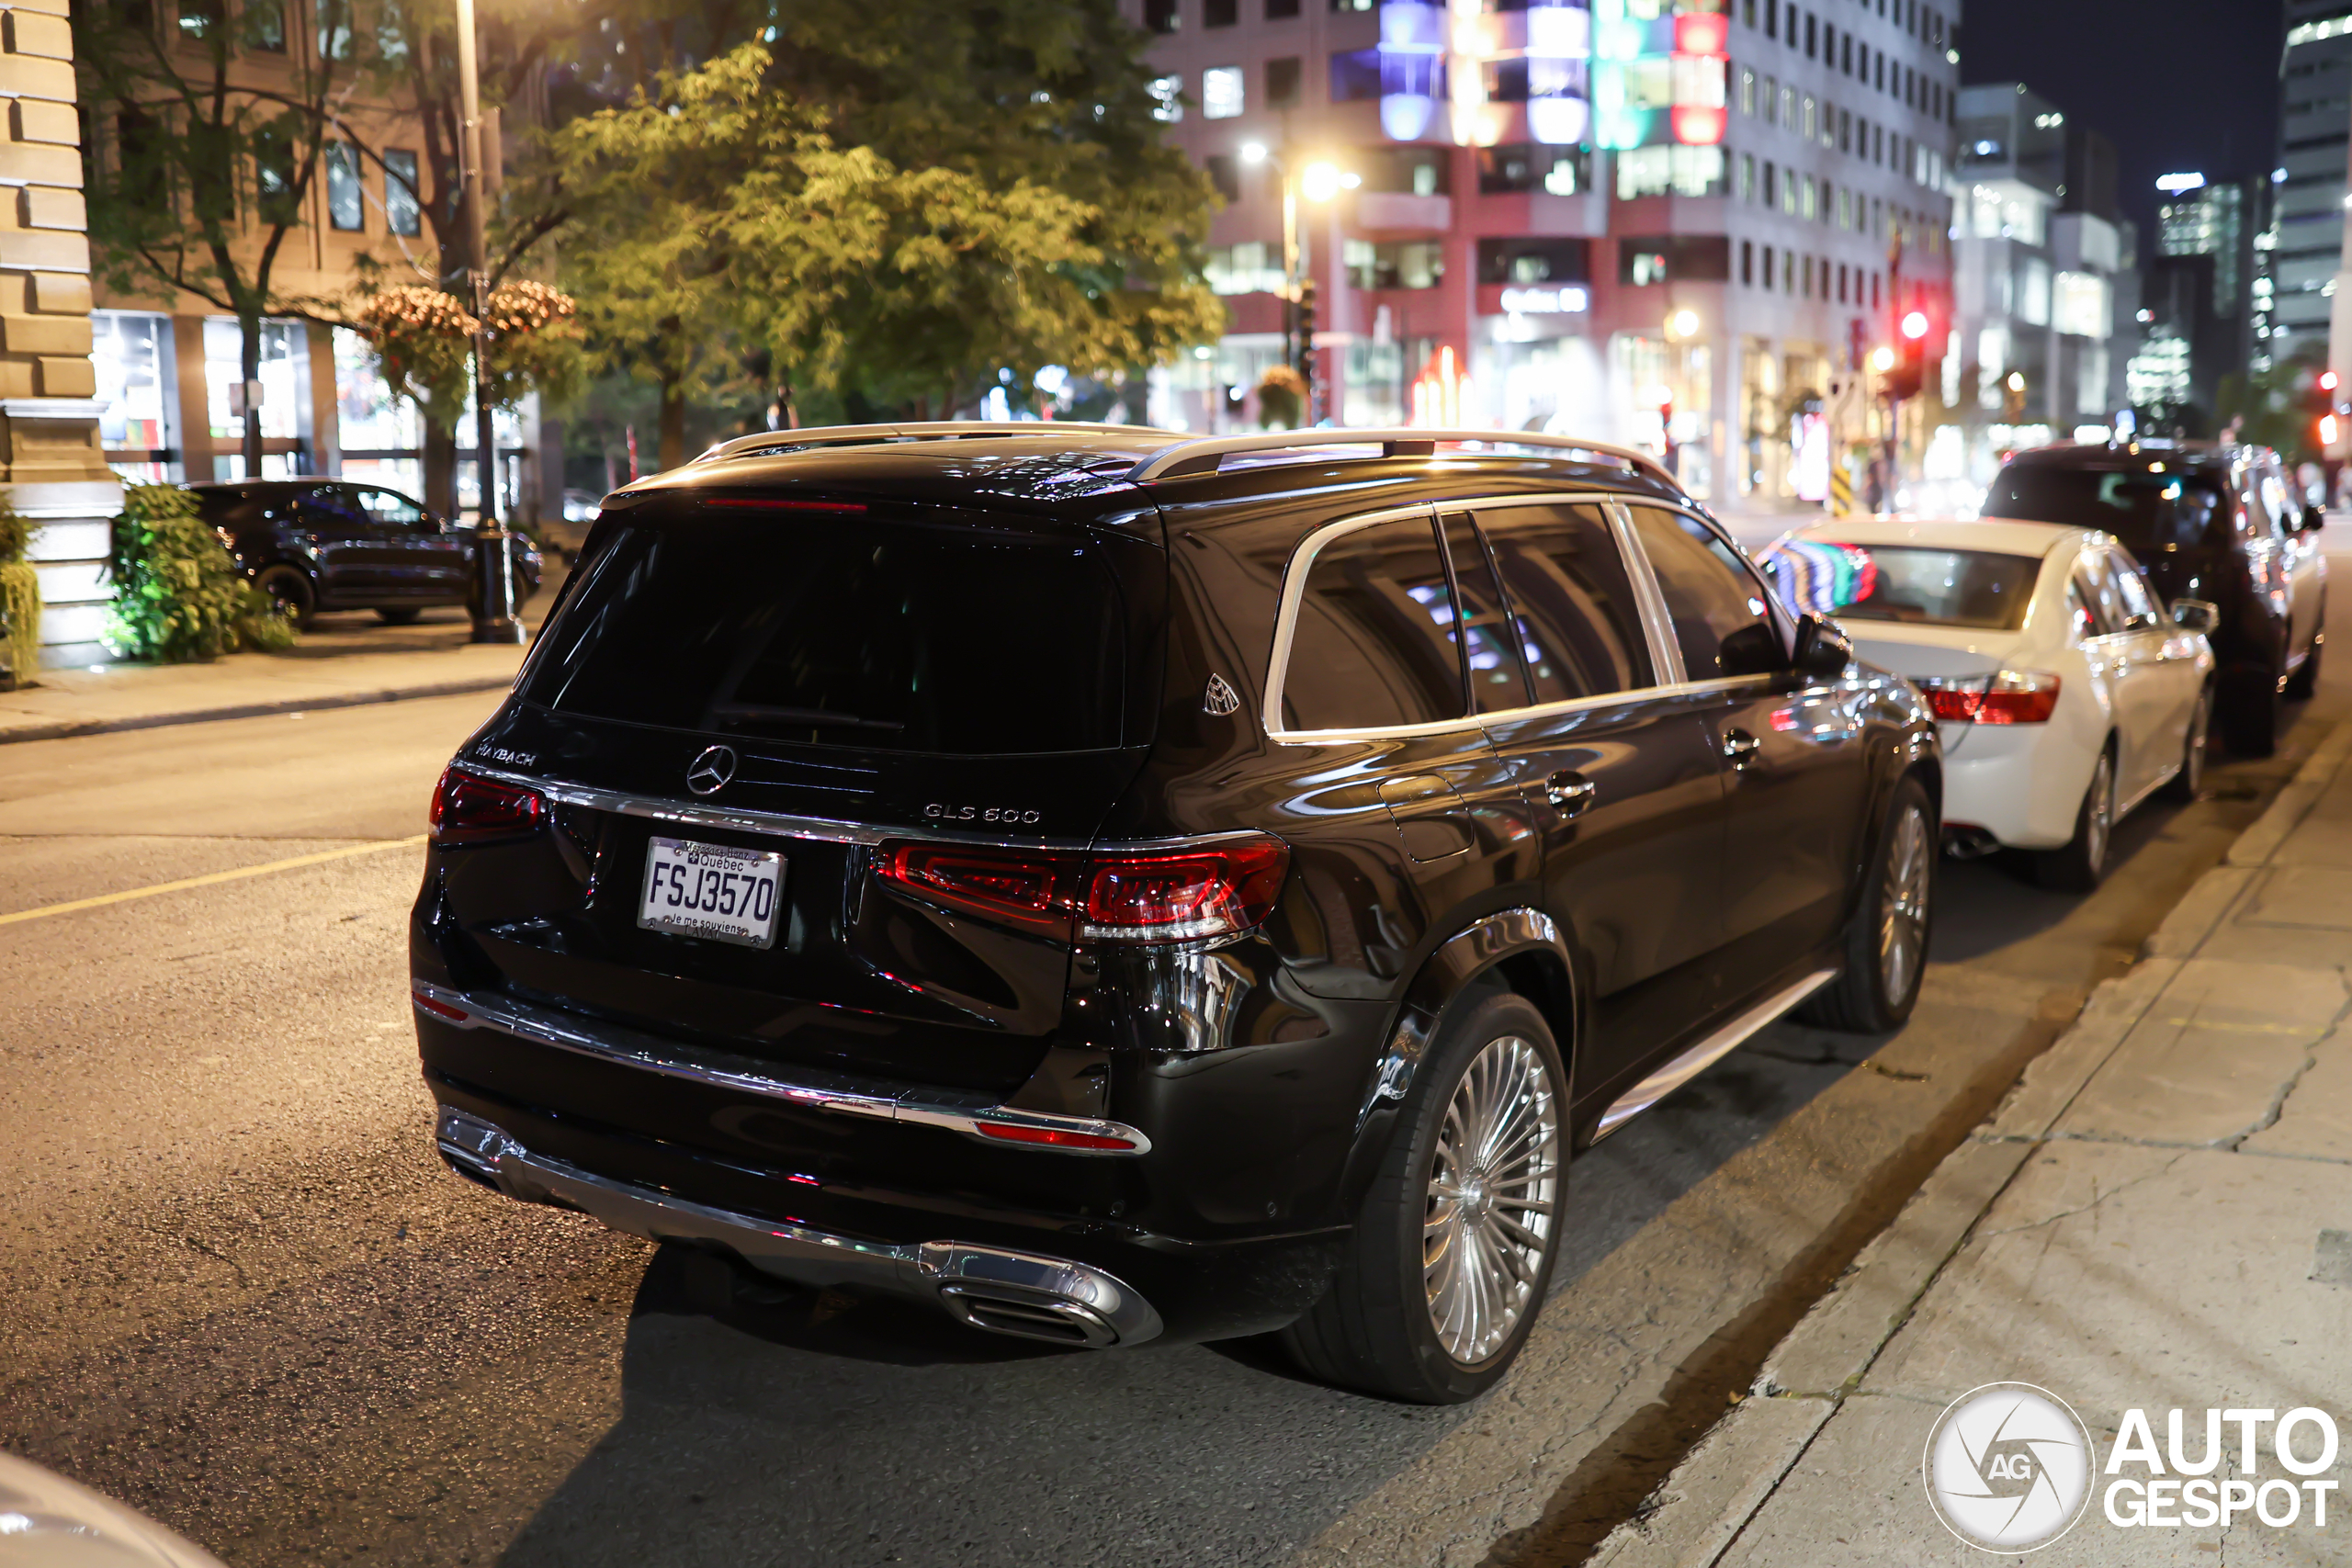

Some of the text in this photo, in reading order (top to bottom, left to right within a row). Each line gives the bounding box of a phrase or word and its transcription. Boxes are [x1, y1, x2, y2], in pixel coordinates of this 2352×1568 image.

[475, 743, 537, 767] MAYBACH
[923, 804, 1040, 824] GLS 600
[650, 861, 774, 921] FSJ3570
[671, 913, 742, 934] Je me souviens
[684, 924, 722, 941] LAVAL
